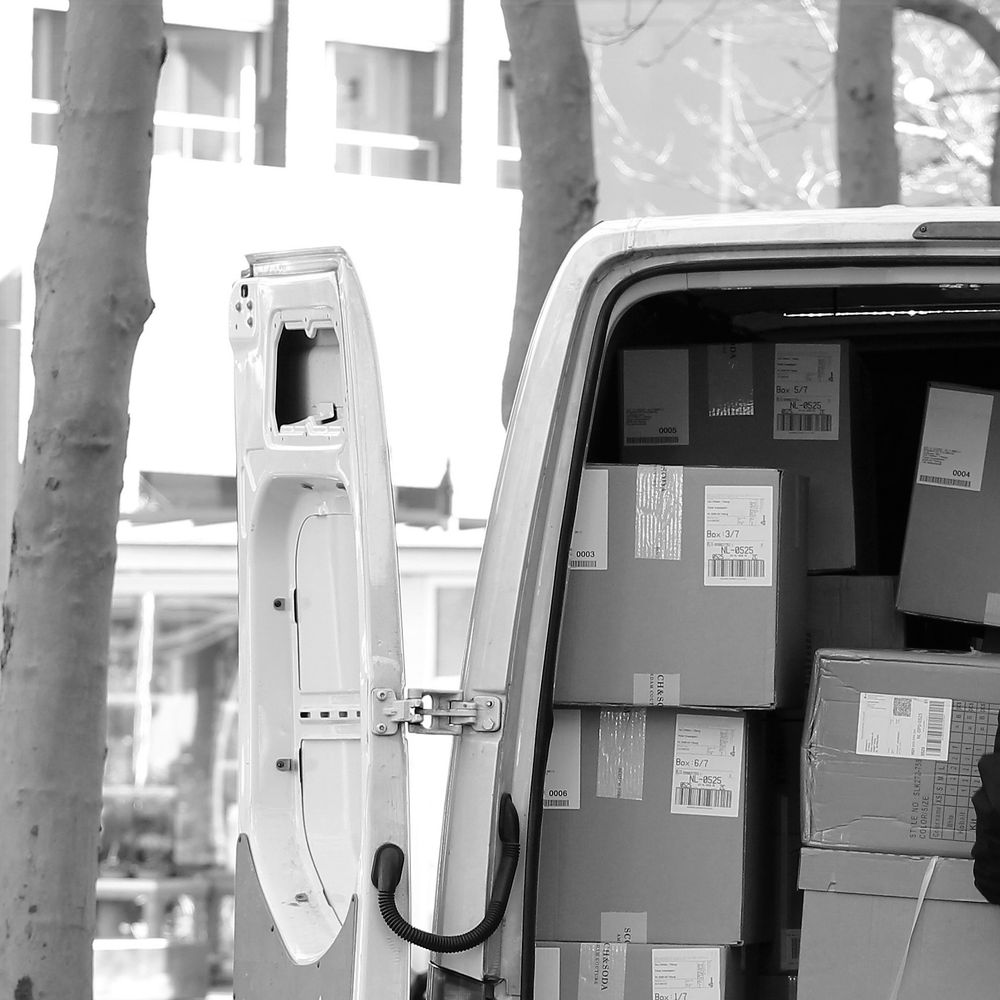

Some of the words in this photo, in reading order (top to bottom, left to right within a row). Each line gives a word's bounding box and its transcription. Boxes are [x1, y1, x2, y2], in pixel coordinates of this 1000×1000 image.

[793, 385, 808, 394] 5/7
[952, 469, 970, 478] 0004
[724, 529, 740, 538] 3/7
[576, 550, 595, 558] 0003
[720, 546, 754, 555] NL-0525
[694, 758, 709, 768] 6/7
[689, 774, 722, 785] NL-0525
[548, 789, 568, 797] 0006
[674, 992, 688, 1000] 1/7
